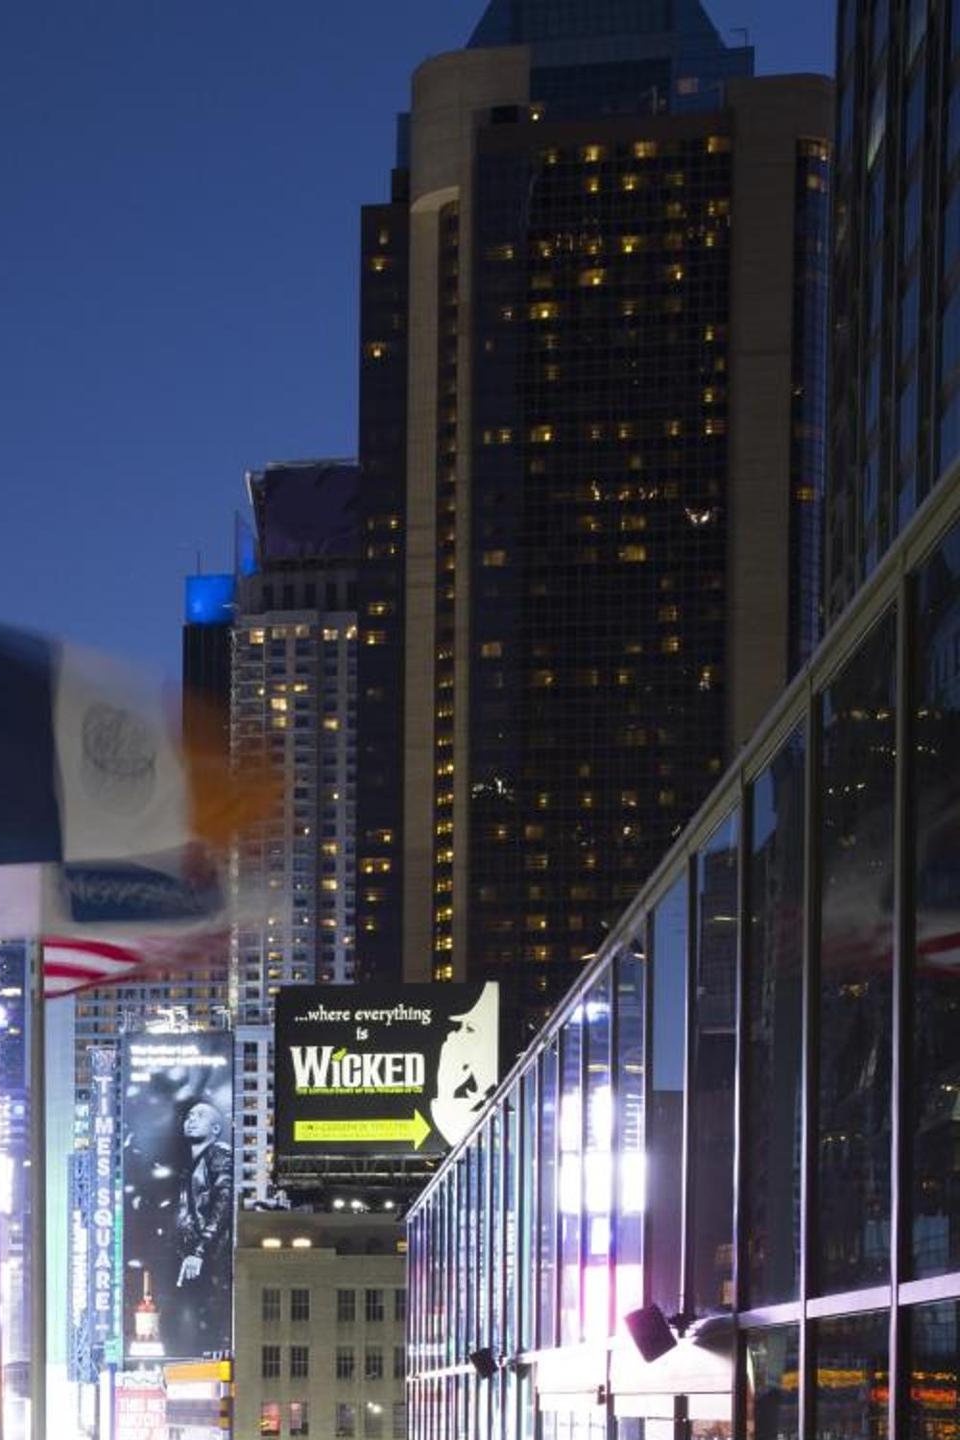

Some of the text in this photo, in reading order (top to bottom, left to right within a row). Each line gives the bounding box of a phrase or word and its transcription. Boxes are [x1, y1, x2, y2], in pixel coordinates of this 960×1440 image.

[294, 1004, 432, 1026] ...where everything
[356, 1027, 369, 1041] is
[93, 1076, 114, 1177] TIMES
[93, 1188, 114, 1312] SQUARE
